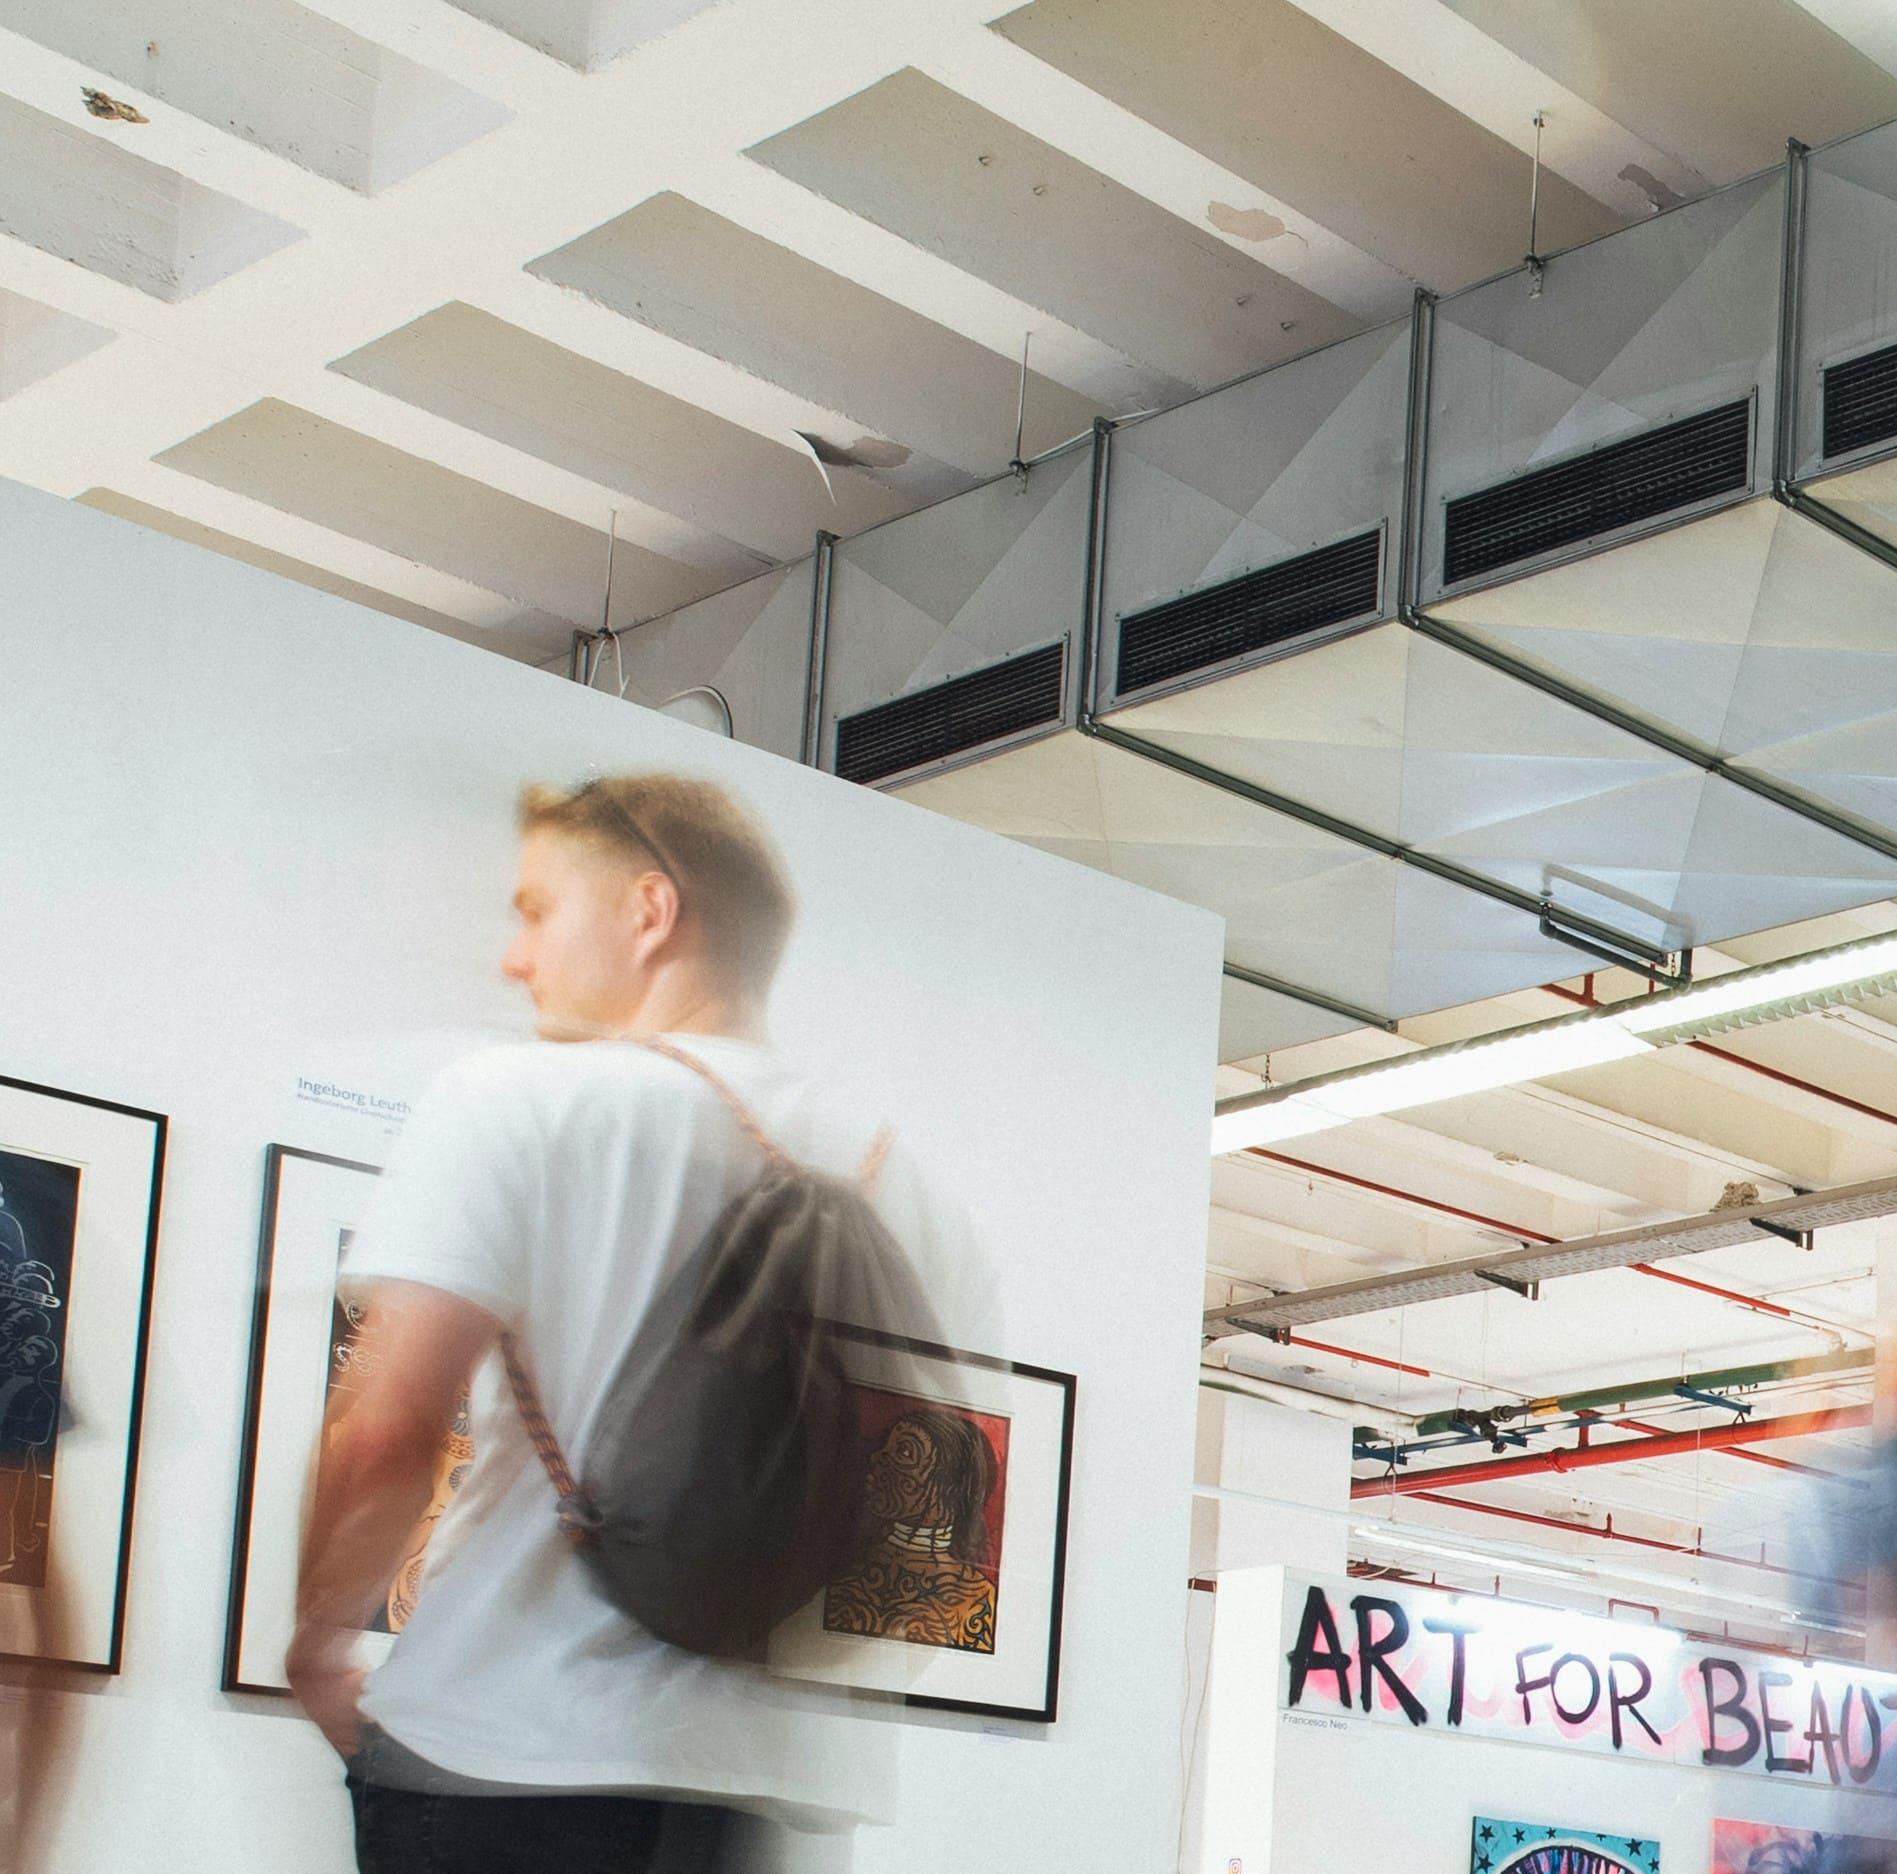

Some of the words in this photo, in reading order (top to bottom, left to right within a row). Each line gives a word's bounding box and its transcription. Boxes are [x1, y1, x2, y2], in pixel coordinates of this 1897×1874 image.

[298, 1078, 365, 1106] Ingeborg
[1286, 1586, 1482, 1726] ART
[1515, 1643, 1661, 1750] FOR
